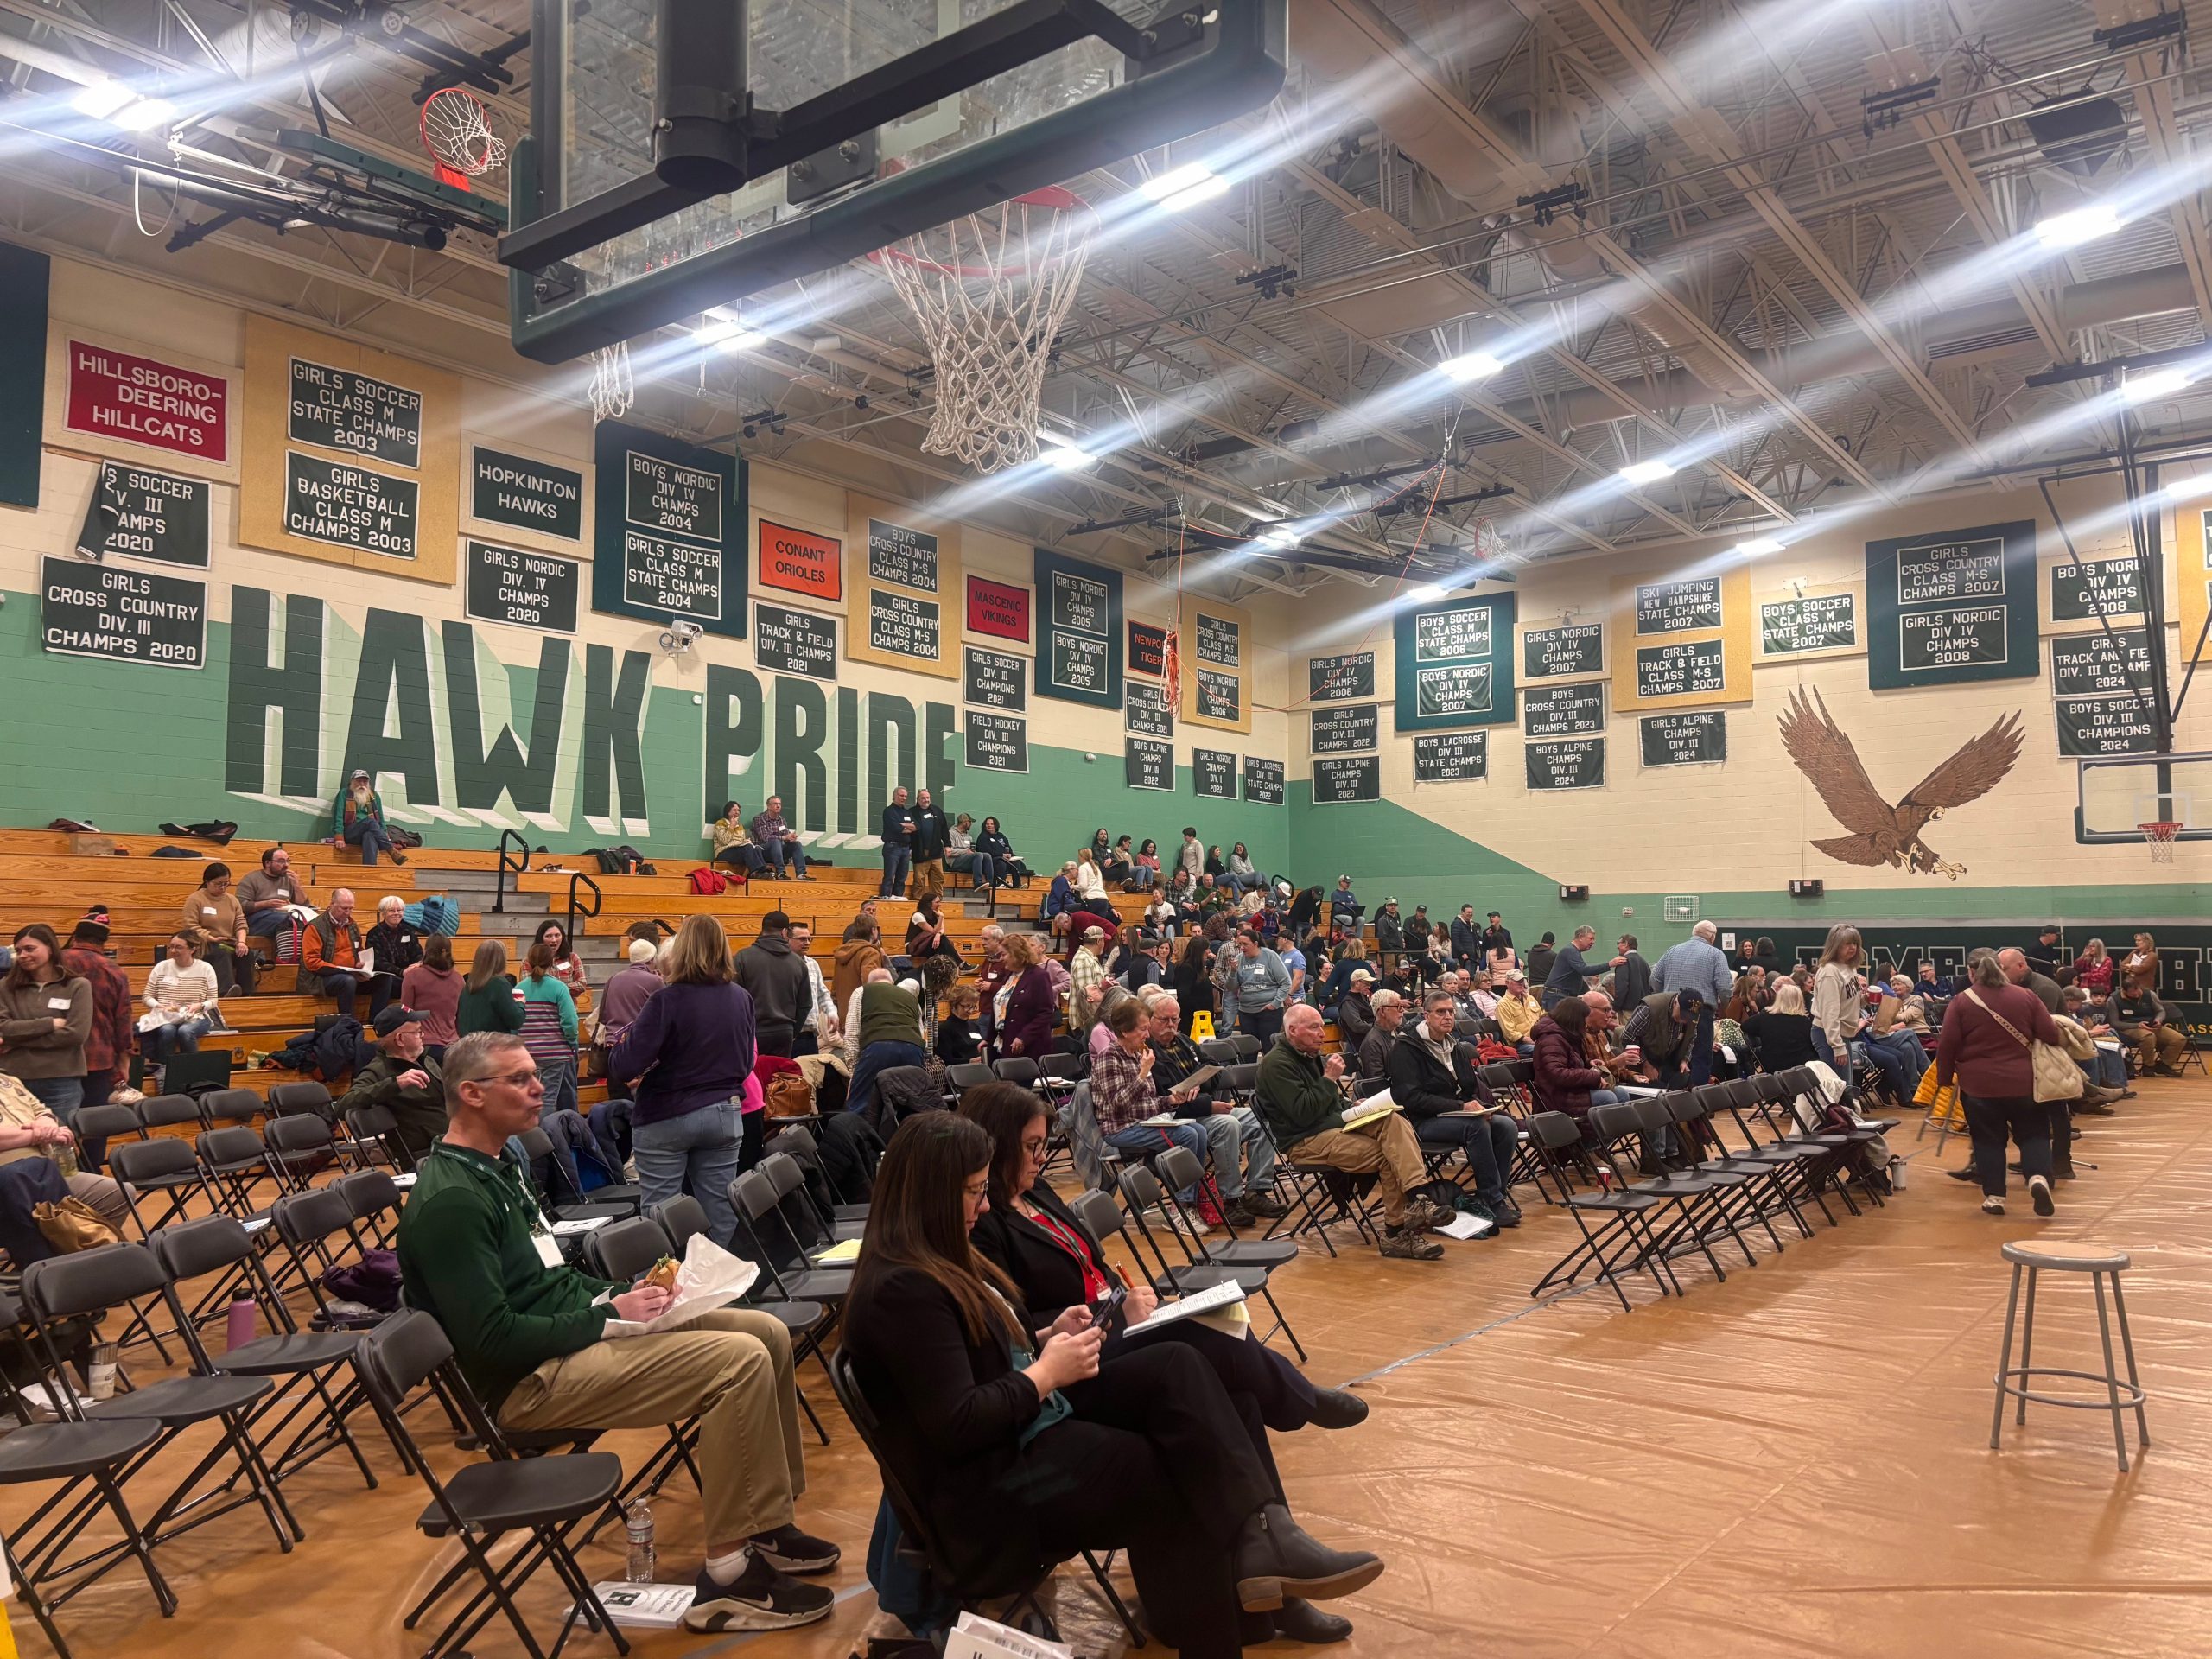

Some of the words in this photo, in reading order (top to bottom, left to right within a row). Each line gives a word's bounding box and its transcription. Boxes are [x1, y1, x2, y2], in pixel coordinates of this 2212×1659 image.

[79, 353, 222, 401] HILLSBORO-
[294, 364, 344, 390] GIRLS
[355, 379, 419, 411] SOCCER
[118, 385, 216, 424] DEERING
[320, 390, 375, 415] CLASS
[383, 406, 394, 422] M
[92, 405, 204, 446] HILLCATS
[293, 400, 343, 427] STATE
[353, 415, 417, 445] CHAMPS
[334, 429, 378, 452] 2003
[331, 468, 380, 493] GIRLS
[480, 463, 576, 501] HOPKINTON
[634, 458, 666, 479] BOYS
[675, 471, 716, 491] NORDIC
[129, 474, 193, 500] SOCCER
[657, 480, 676, 496] DIV
[684, 488, 695, 500] IV
[145, 496, 163, 513] III
[298, 477, 409, 517] BASKETBALL
[499, 492, 557, 519] HAWKS
[652, 495, 699, 517] CHAMPS
[118, 512, 166, 534] AMPS
[316, 501, 372, 526] CLASS
[380, 516, 391, 531] M
[659, 512, 692, 530] 2004
[291, 513, 360, 541] CHAMPS
[368, 531, 411, 552] 2003
[892, 529, 916, 545] BOYS
[105, 532, 154, 552] 2020
[870, 536, 897, 553] CROSS
[900, 544, 937, 563] COUNTRY
[628, 537, 664, 557] GIRLS
[672, 548, 719, 568] SOCCER
[775, 540, 825, 563] CONANT
[1930, 547, 1969, 560] GIRLS
[484, 550, 518, 569] GIRLS
[525, 558, 565, 577] NORDIC
[646, 557, 686, 578] CLASS
[695, 567, 702, 581] M
[775, 561, 825, 583] ORIOLES
[880, 552, 909, 569] CLASS
[912, 561, 928, 574] M-S
[1902, 563, 1940, 575] CROSS
[1946, 556, 1999, 570] COUNTRY
[102, 572, 151, 594] GIRLS
[503, 571, 525, 588] DIV.
[536, 577, 546, 590] IV
[628, 569, 667, 588] STATE
[672, 579, 718, 598] CHAMPS
[872, 563, 908, 582] CHAMPS
[912, 574, 936, 588] 2004
[1913, 572, 1956, 586] CLASS
[1966, 569, 1988, 581] M-S
[499, 588, 549, 607] CHAMPS
[658, 591, 691, 608] 2004
[1642, 588, 1659, 599] SKI
[1668, 582, 1713, 595] JUMPING
[1904, 584, 1955, 600] CHAMPS
[1964, 581, 1999, 593] 2007
[48, 585, 107, 608] CROSS
[120, 596, 198, 621] COUNTRY
[893, 598, 919, 613] GIRLS
[975, 590, 1021, 613] MASCENIC
[1644, 599, 1660, 609] NEW
[1668, 593, 1713, 607] HAMPSHIRE
[1764, 604, 1796, 617] BOYS
[1802, 597, 1851, 612] SOCCER
[507, 607, 540, 623] 2020
[871, 605, 899, 622] CROSS
[901, 613, 938, 631] COUNTRY
[982, 609, 1017, 627] VIKINGS
[1420, 616, 1444, 627] BOYS
[1450, 611, 1487, 623] SOCCER
[1639, 608, 1670, 620] STATE
[1675, 602, 1719, 616] CHAMPS
[1780, 613, 1819, 626] CLASS
[1827, 611, 1834, 620] M
[1905, 615, 1943, 628] GIRLS
[1953, 610, 2001, 623] NORDIC
[99, 613, 131, 633] DIV.
[137, 620, 151, 635] III
[785, 614, 810, 629] GIRLS
[1432, 626, 1463, 636] CLASS
[1468, 624, 1474, 632] M
[1664, 617, 1693, 629] 2007
[1764, 626, 1799, 639] STATE
[1806, 620, 1853, 634] CHAMPS
[760, 623, 791, 639] TRACK
[797, 631, 803, 642] &
[808, 632, 833, 648] FIELD
[881, 622, 911, 639] CLASS
[914, 629, 930, 642] M-S
[1419, 637, 1446, 648] STATE
[1451, 632, 1488, 645] CHAMPS
[1527, 632, 1556, 643] GIRLS
[1562, 626, 1599, 638] NORDIC
[1931, 627, 1952, 639] DIV
[1961, 625, 1974, 636] IV
[48, 628, 137, 654] CHAMPS
[149, 642, 196, 661] 2020
[761, 638, 779, 652] DIV.
[784, 642, 792, 654] III
[797, 645, 832, 662] CHAMPS
[874, 633, 910, 651] CHAMPS
[913, 642, 938, 656] 2004
[1440, 645, 1466, 656] 2006
[1547, 643, 1562, 652] DIV
[1568, 640, 1579, 649] IV
[1792, 635, 1824, 648] 2007
[1926, 638, 1979, 652] CHAMPS
[1542, 651, 1583, 663] CHAMPS
[1662, 646, 1695, 658] GIRLS
[1935, 652, 1970, 664] 2008
[787, 658, 808, 671] 2021
[972, 652, 991, 665] GIRLS
[995, 657, 1020, 671] SOCCER
[1549, 662, 1576, 673] 2007
[1639, 660, 1672, 672] TRACK
[1678, 658, 1686, 668] &
[1691, 655, 1721, 667] FIELD
[983, 668, 997, 679] DIV.
[1422, 671, 1446, 682] BOYS
[1452, 667, 1486, 678] NORDIC
[1649, 671, 1685, 683] CLASS
[1693, 667, 1711, 678] M-S
[976, 679, 1015, 694] CHAMPIONS
[1439, 681, 1454, 690] DIV
[1459, 679, 1468, 689] IV
[1640, 682, 1683, 695] CHAMPS
[1692, 678, 1721, 690] 2007
[988, 693, 1004, 704] 2021
[1435, 690, 1473, 702] CHAMPS
[225, 583, 652, 829] HAWK
[703, 663, 958, 839] PRIDE
[1333, 710, 1354, 719] GIRLS
[1442, 701, 1465, 711] 2007
[972, 715, 992, 727] FIELD
[995, 719, 1020, 731] HOCKEY
[1313, 721, 1338, 730] CROSS
[1340, 718, 1375, 728] COUNTRY
[984, 729, 997, 741] DIV.
[1319, 741, 1348, 749] CHAMPS
[1353, 738, 1370, 747] 2022
[977, 741, 1016, 755] CHAMPIONS
[989, 755, 1006, 766] 2021
